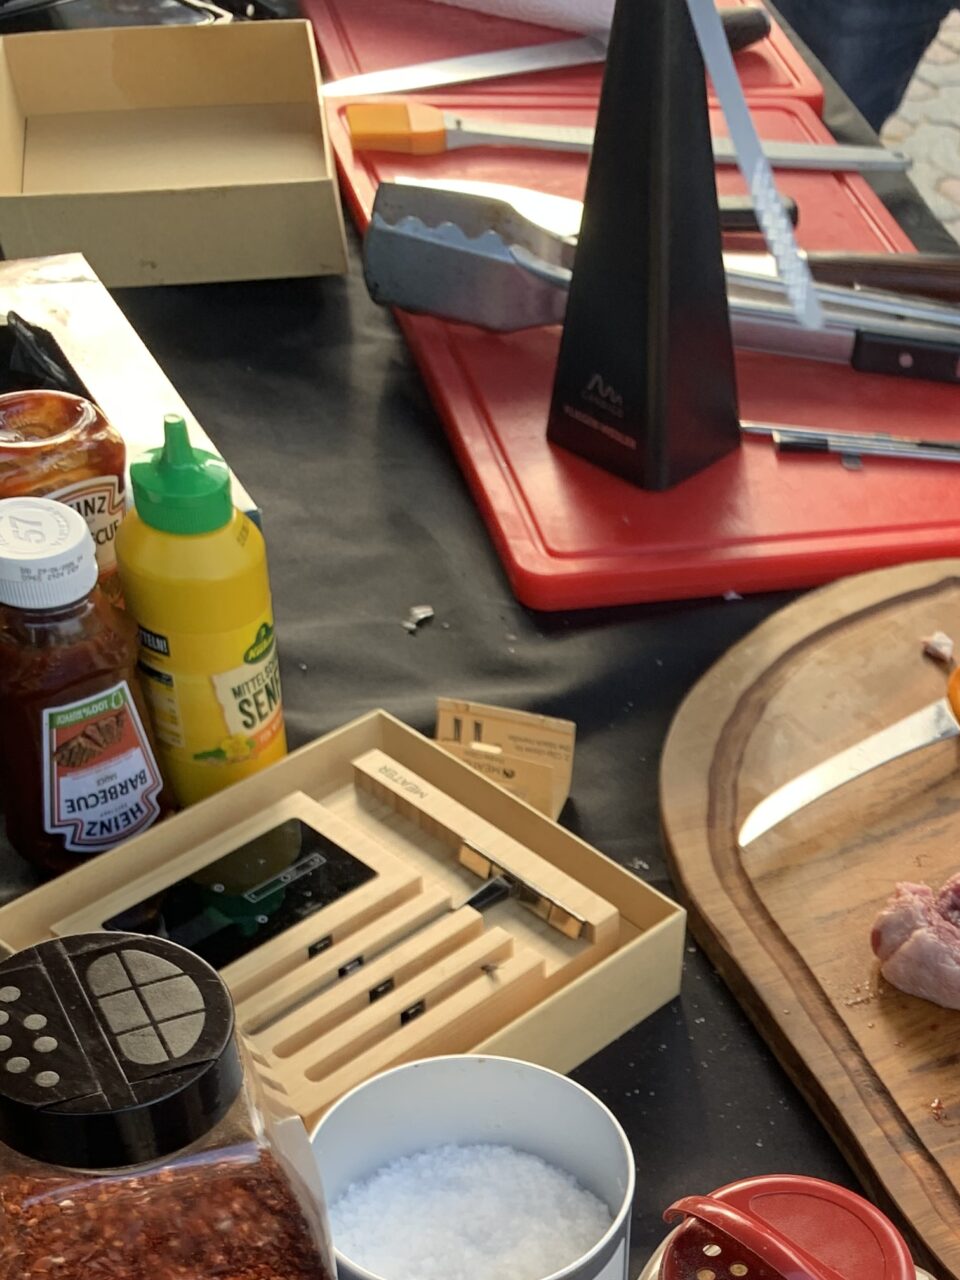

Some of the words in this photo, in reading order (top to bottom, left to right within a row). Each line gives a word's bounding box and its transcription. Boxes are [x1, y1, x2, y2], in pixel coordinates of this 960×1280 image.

[67, 495, 106, 516] INZ
[64, 769, 148, 813] BARBECUE
[85, 802, 144, 839] HEINZ
